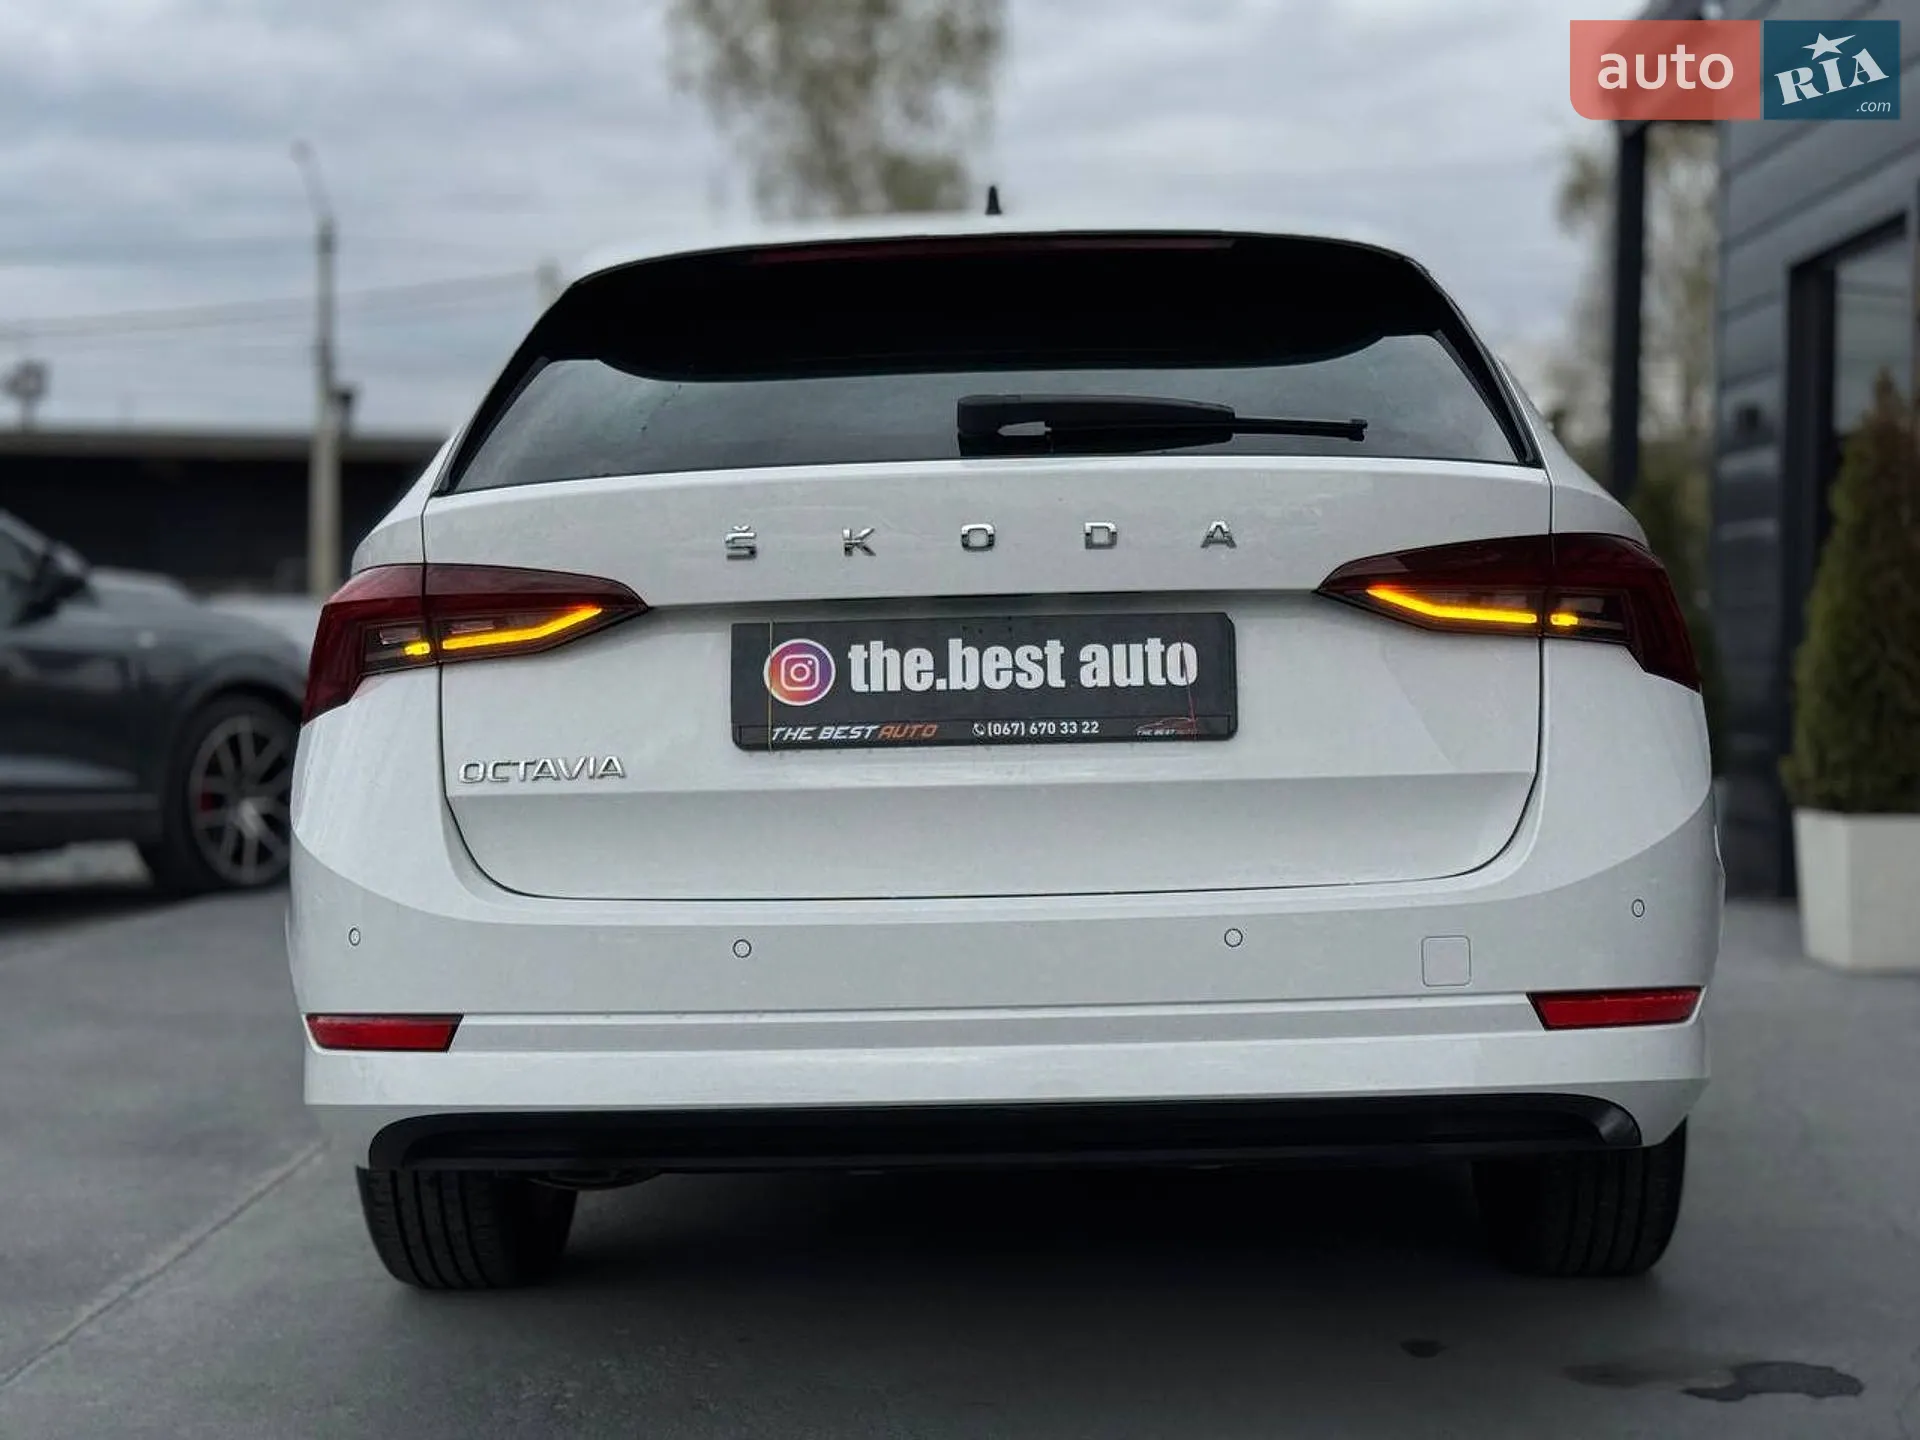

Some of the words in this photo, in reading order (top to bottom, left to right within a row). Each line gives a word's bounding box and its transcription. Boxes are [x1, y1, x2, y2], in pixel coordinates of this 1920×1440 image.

[724, 520, 1237, 560] ŠKODA
[848, 638, 1066, 692] the.best
[1079, 637, 1198, 689] auto
[771, 726, 817, 741] THE
[817, 725, 880, 741] BEST
[876, 723, 939, 740] AUTO
[987, 721, 1026, 737] (067)
[1029, 721, 1056, 735] 670
[1060, 721, 1078, 735] 33
[1081, 720, 1100, 734] 22
[458, 754, 627, 784] OCTAVIA
